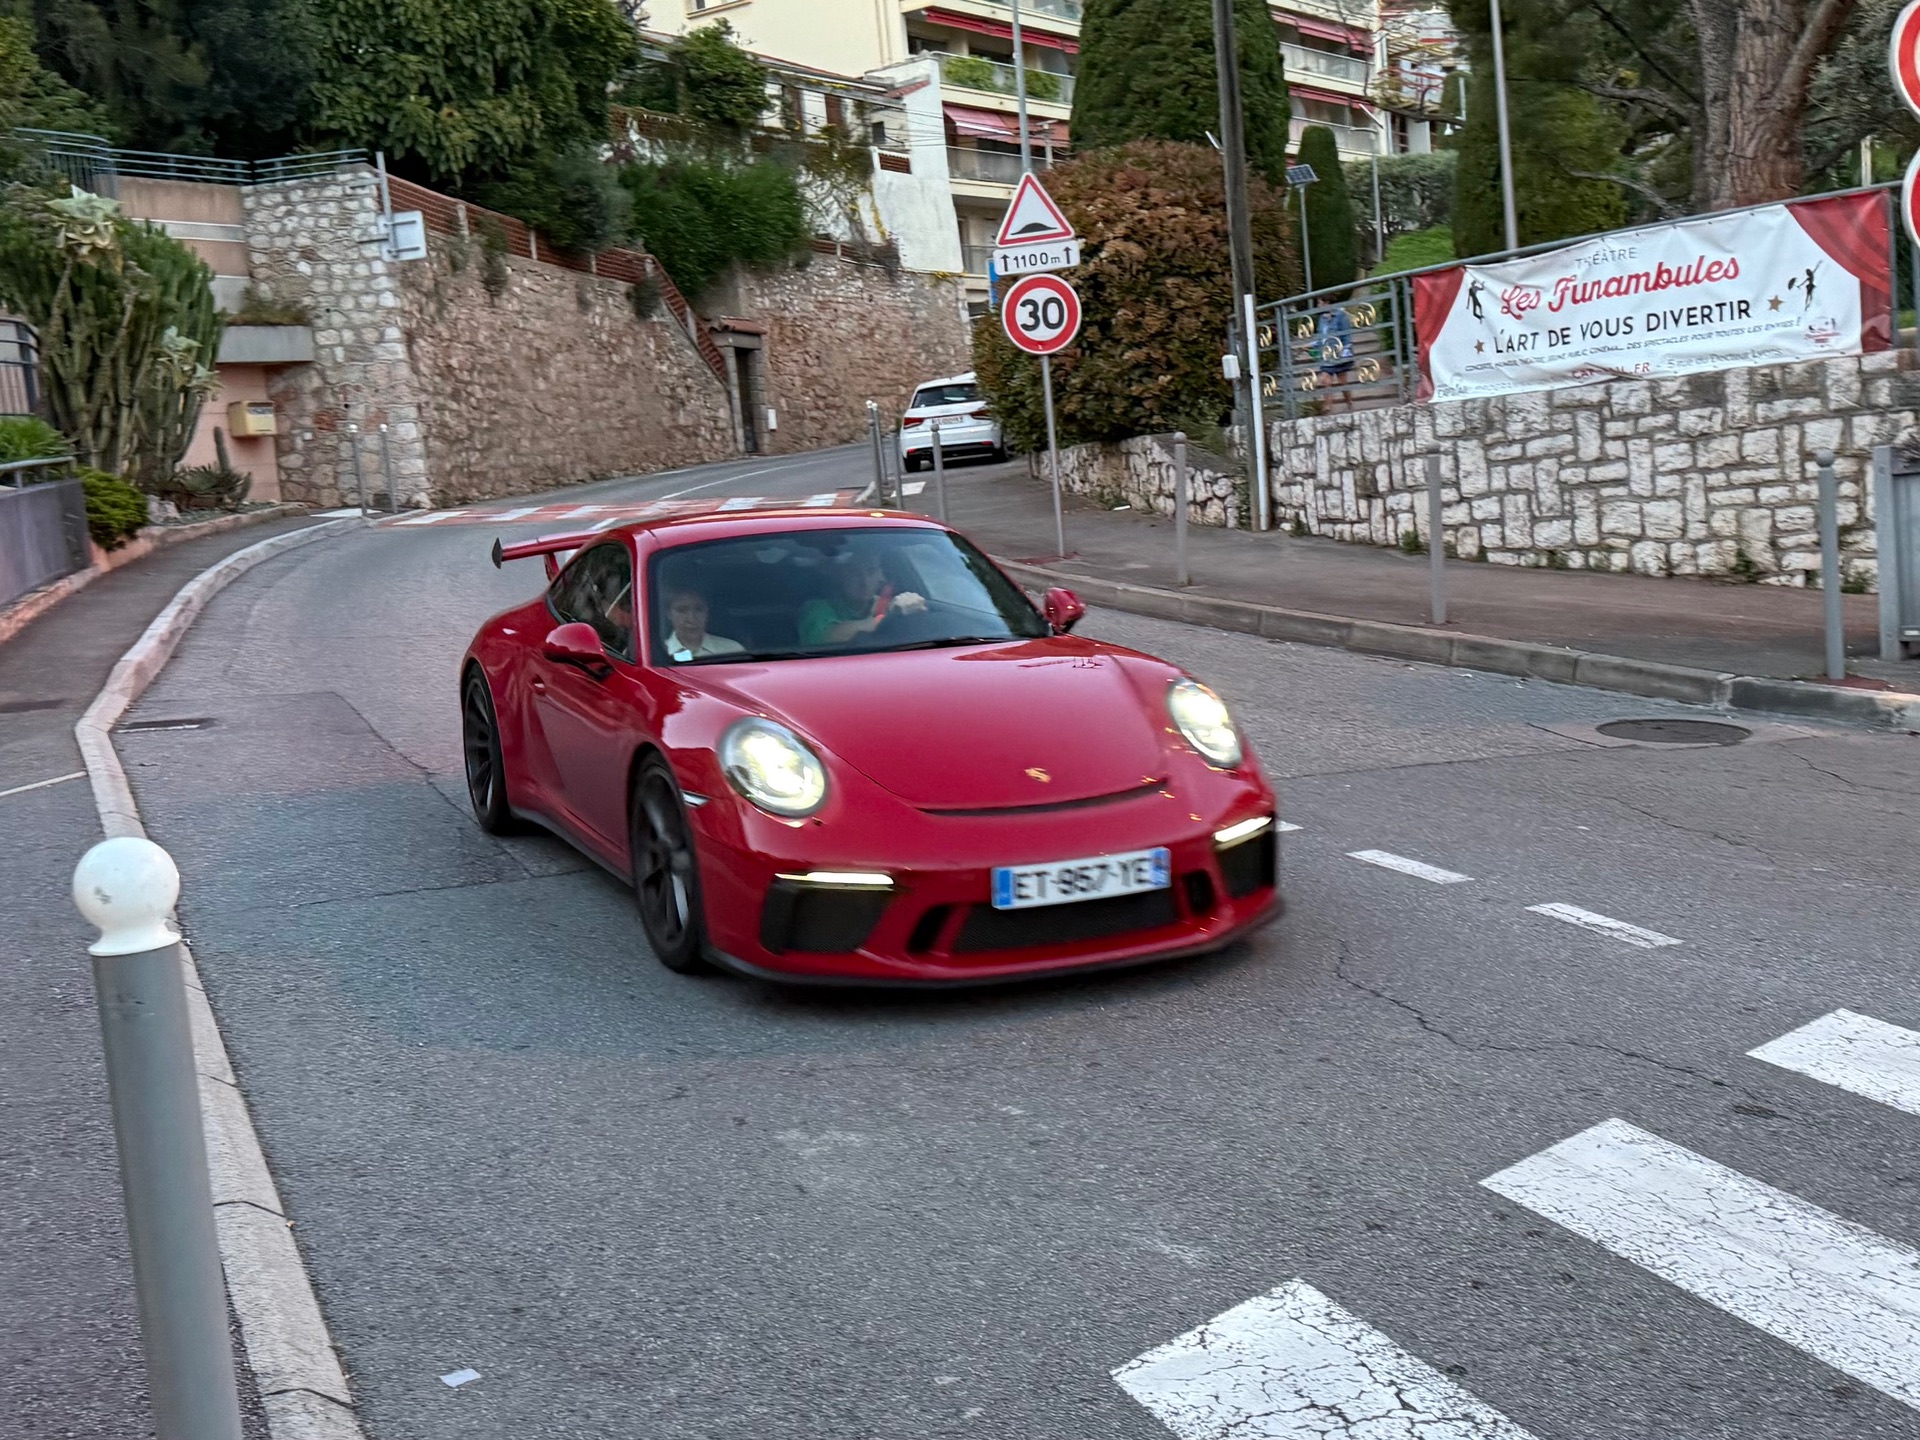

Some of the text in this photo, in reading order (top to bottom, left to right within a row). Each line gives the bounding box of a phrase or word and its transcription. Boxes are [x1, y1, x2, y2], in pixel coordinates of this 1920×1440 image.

[1020, 296, 1065, 332] 30
[1500, 255, 1740, 320] Les Funambules
[1494, 299, 1751, 354] L'ART DE VOUS DIVERTIR
